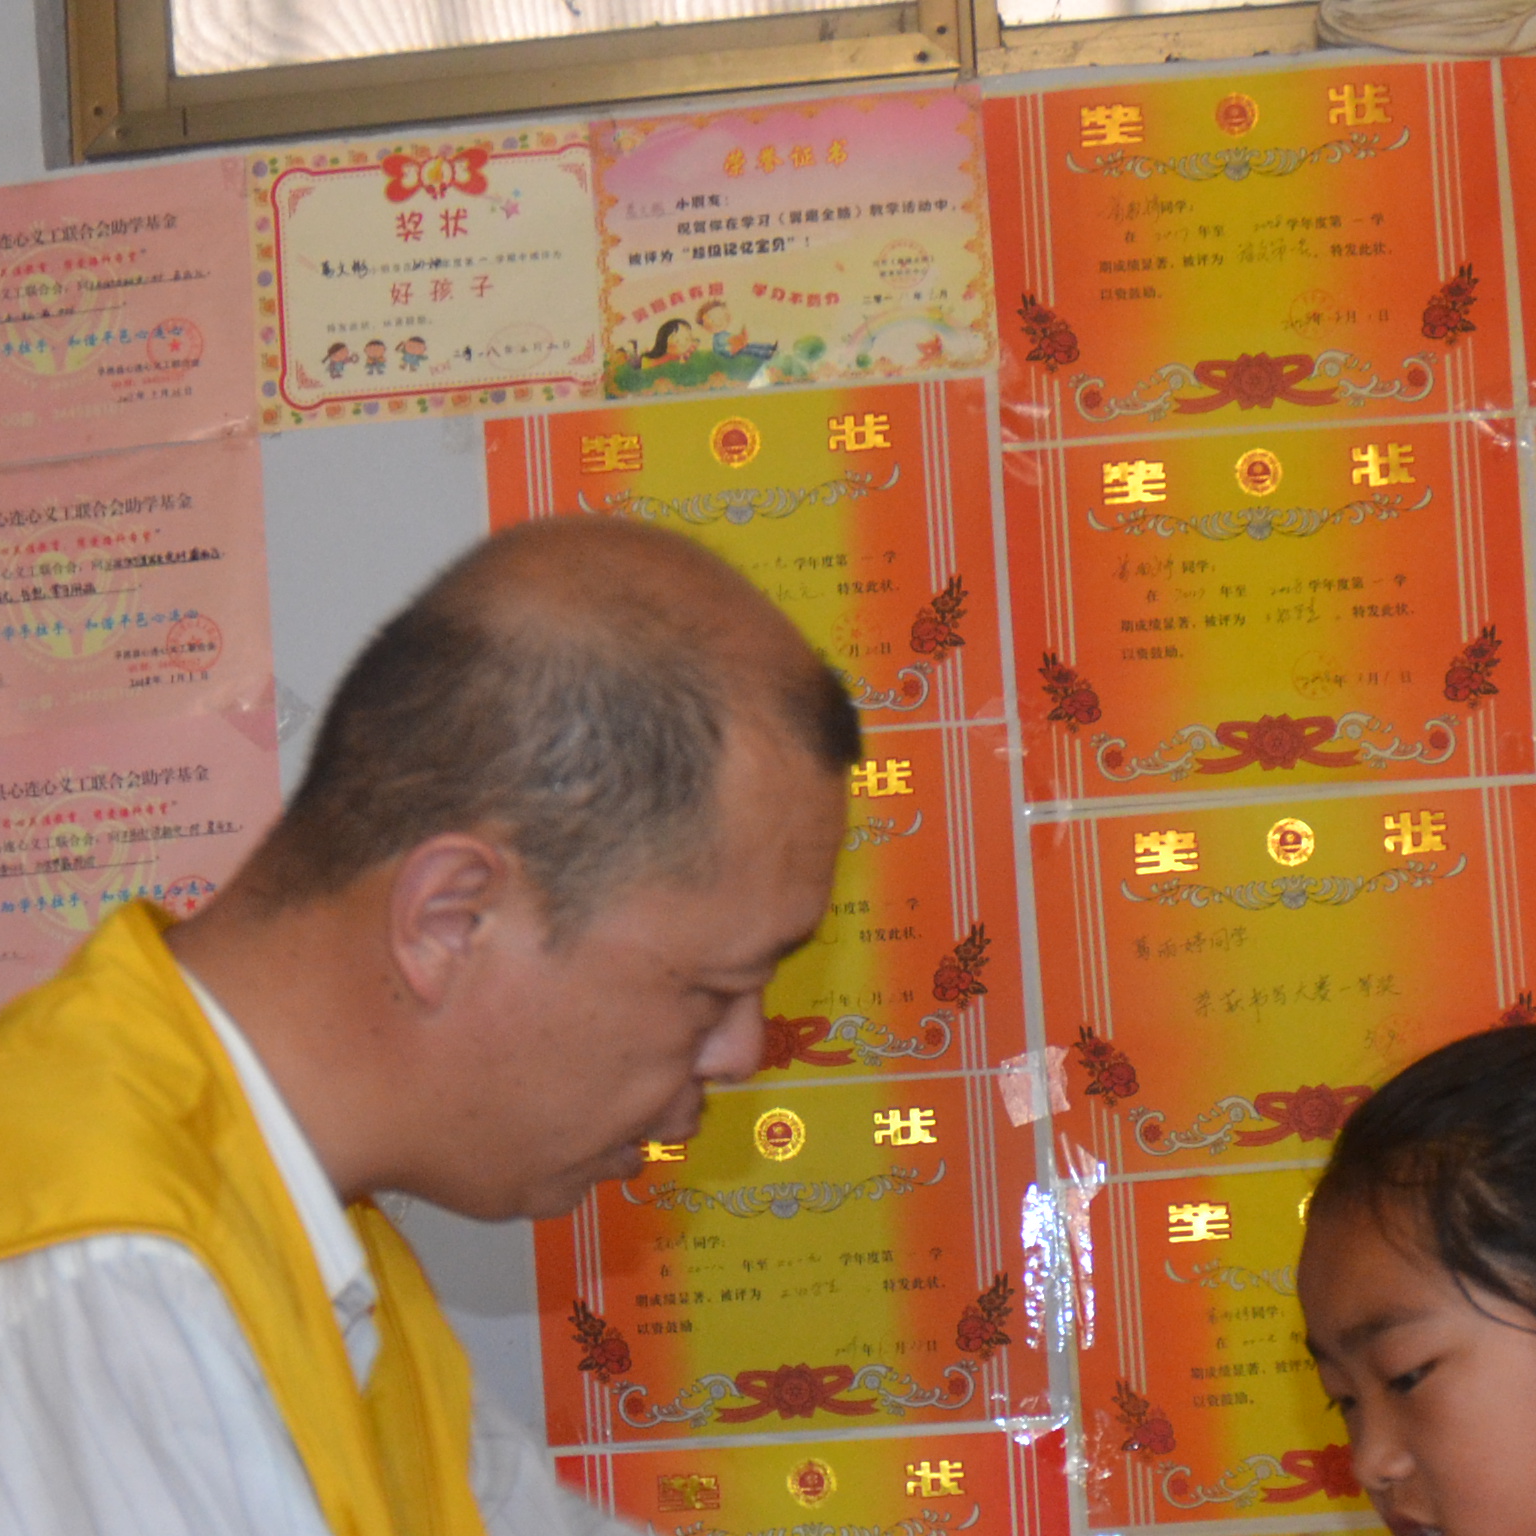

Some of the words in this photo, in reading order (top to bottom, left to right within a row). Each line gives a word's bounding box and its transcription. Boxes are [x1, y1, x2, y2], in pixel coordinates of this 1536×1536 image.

[1080, 104, 1145, 147] 奖
[1327, 83, 1392, 126] 状
[724, 139, 849, 177] 荣誉证书
[391, 275, 493, 305] 好孩子
[827, 412, 892, 453] 状
[1102, 460, 1166, 505] 奖
[1351, 442, 1416, 487] 状
[851, 758, 914, 798] 状
[1133, 830, 1200, 876] 奖
[1383, 810, 1448, 855] 状
[874, 1106, 938, 1146] 状
[1167, 1202, 1232, 1244] 奖
[905, 1459, 965, 1498] 状
